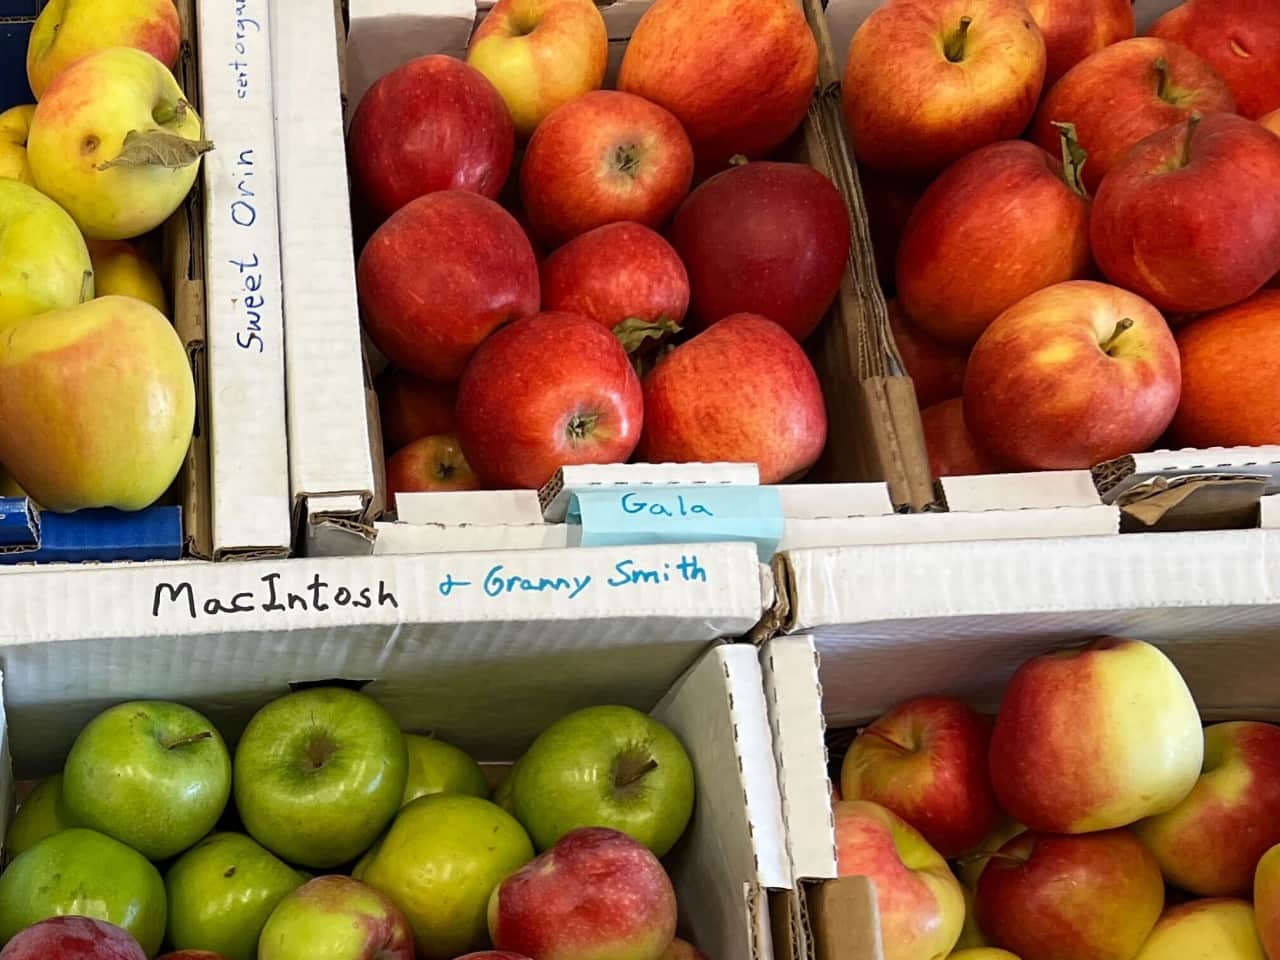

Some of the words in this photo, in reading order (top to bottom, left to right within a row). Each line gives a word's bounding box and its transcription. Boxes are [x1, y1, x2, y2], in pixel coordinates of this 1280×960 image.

[231, 149, 257, 228] Orin
[229, 253, 264, 353] Sweet
[620, 491, 715, 517] Gala
[151, 572, 400, 618] MacIntosh
[483, 565, 592, 599] Granny
[606, 555, 708, 586] Smith
